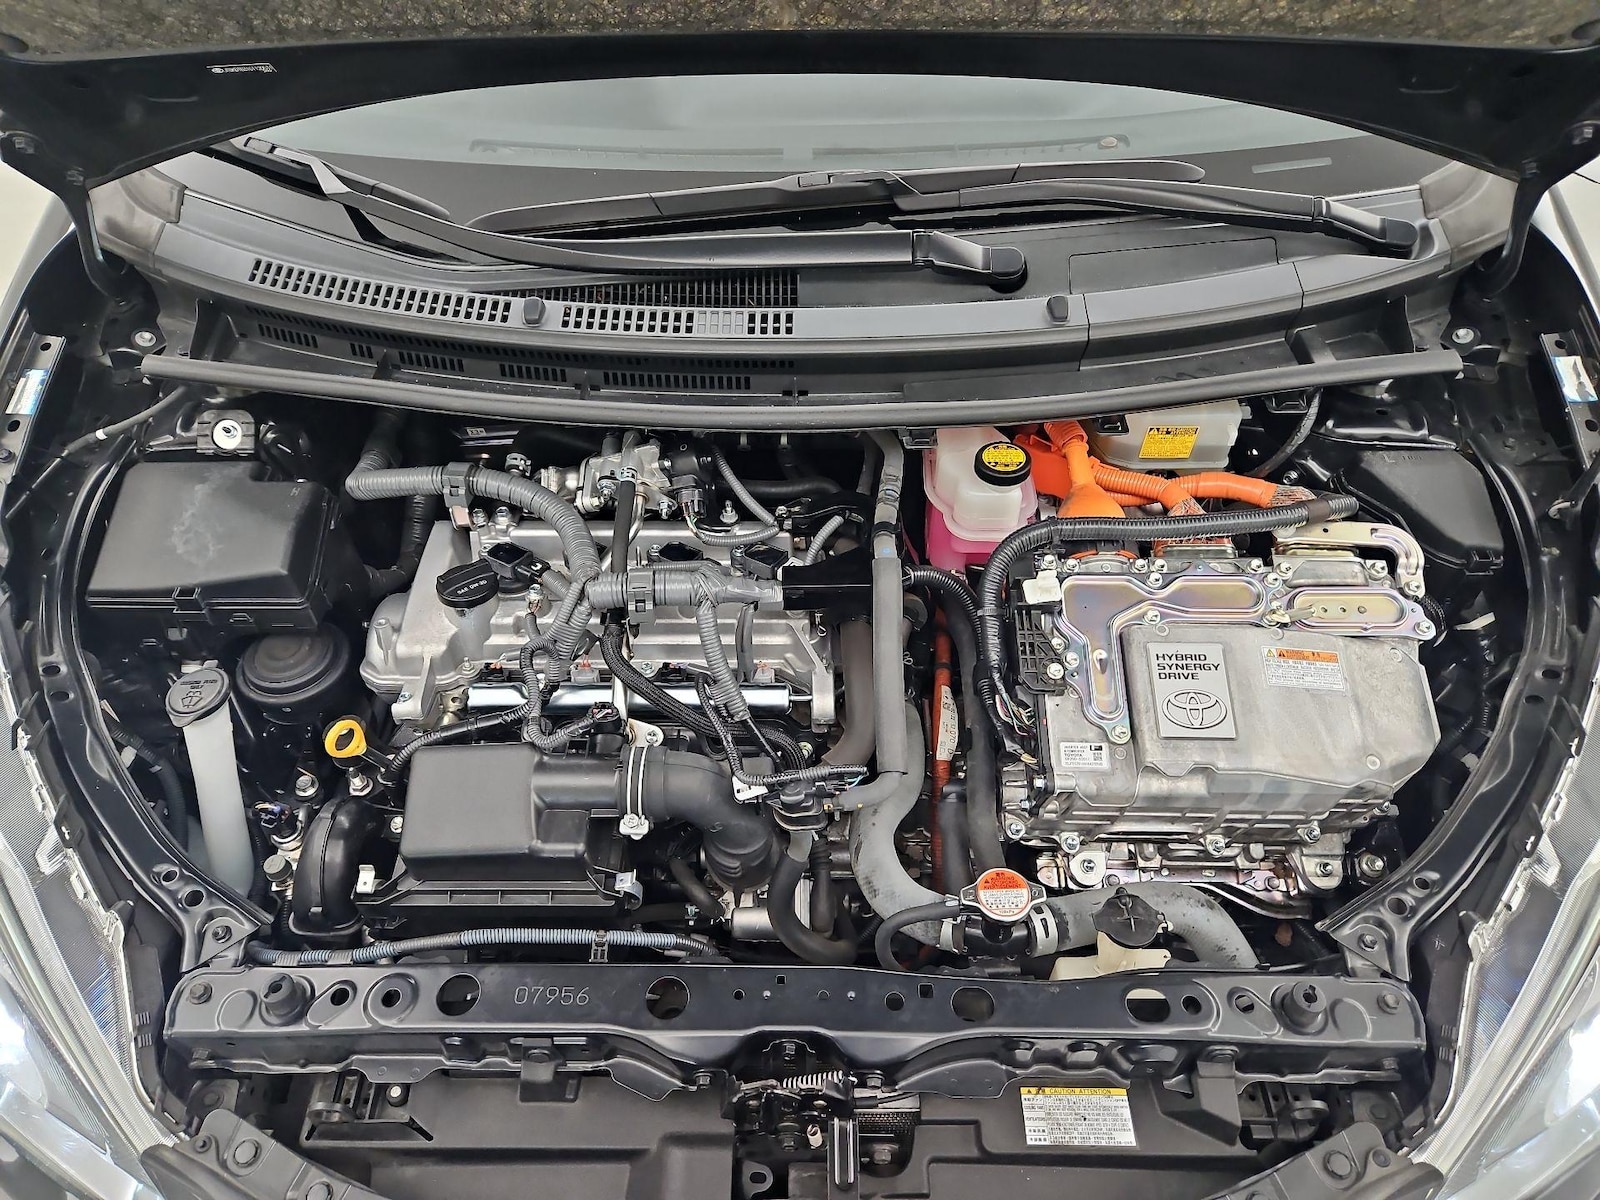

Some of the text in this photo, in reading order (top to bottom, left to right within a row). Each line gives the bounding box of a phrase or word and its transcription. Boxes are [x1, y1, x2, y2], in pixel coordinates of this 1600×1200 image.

[1155, 653, 1207, 662] HYBRID
[1157, 663, 1220, 671] SYNERGY
[1158, 672, 1200, 680] DRIVE
[513, 985, 590, 1006] 07956
